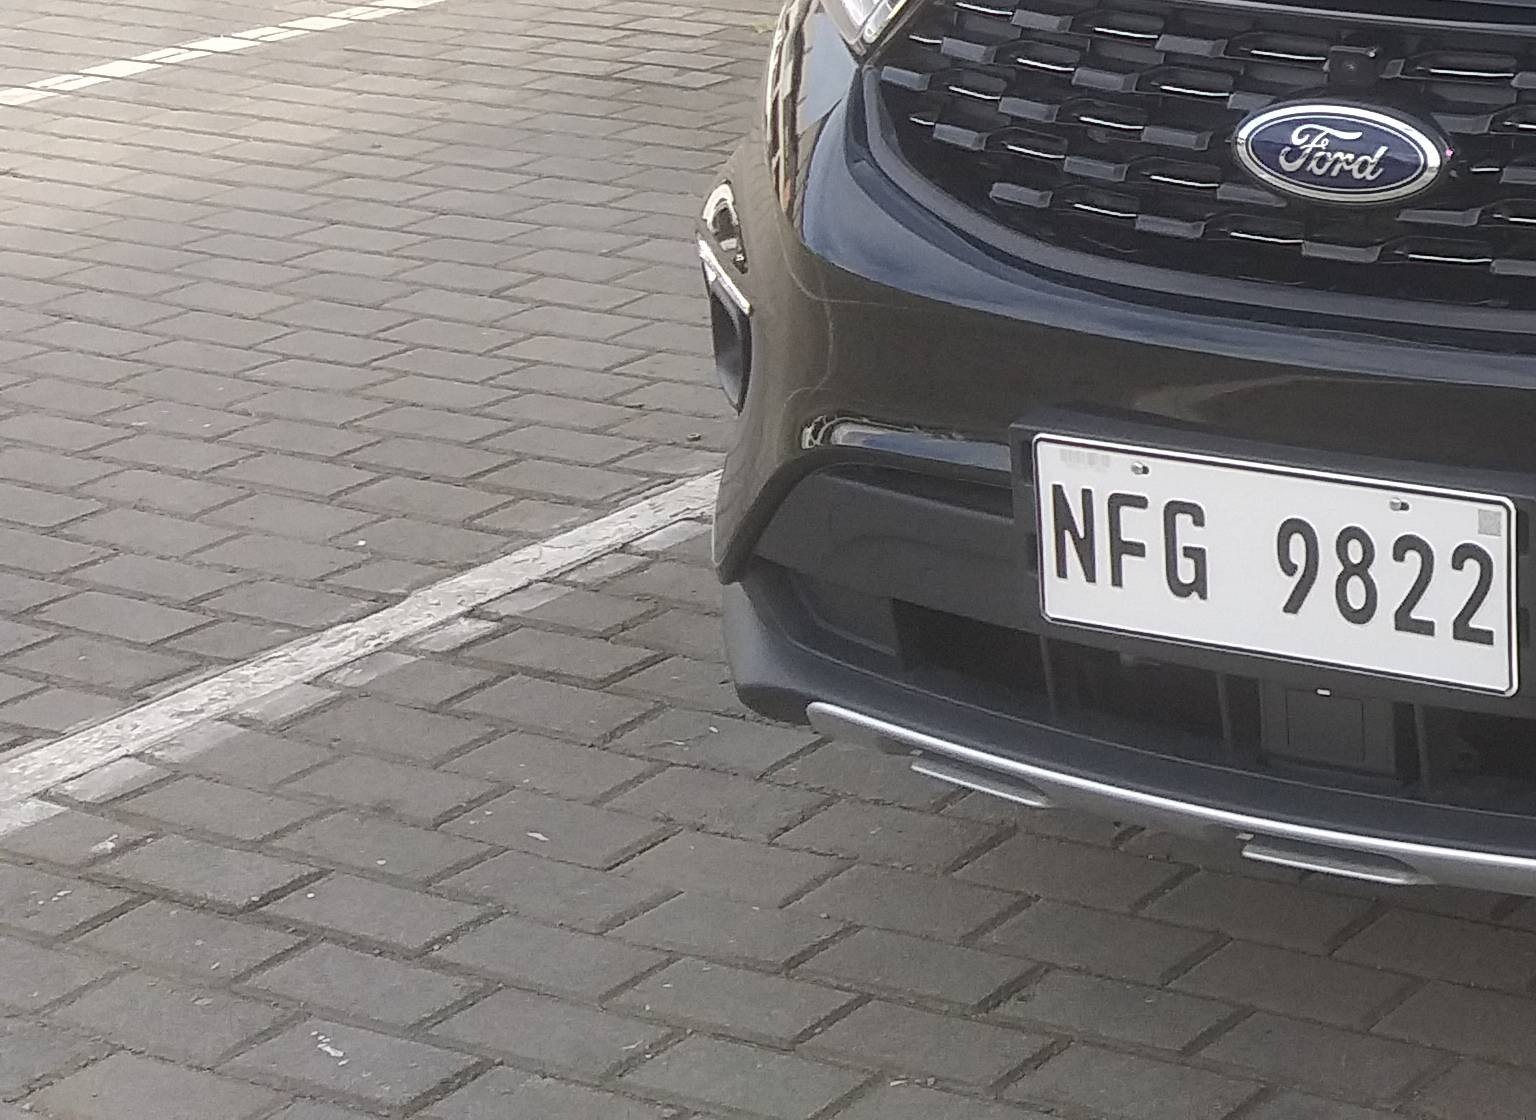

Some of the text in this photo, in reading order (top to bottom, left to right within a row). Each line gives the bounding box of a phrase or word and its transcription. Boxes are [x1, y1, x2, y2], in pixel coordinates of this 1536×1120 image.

[1278, 123, 1390, 181] Ford
[1051, 483, 1496, 647] NFG 9822
